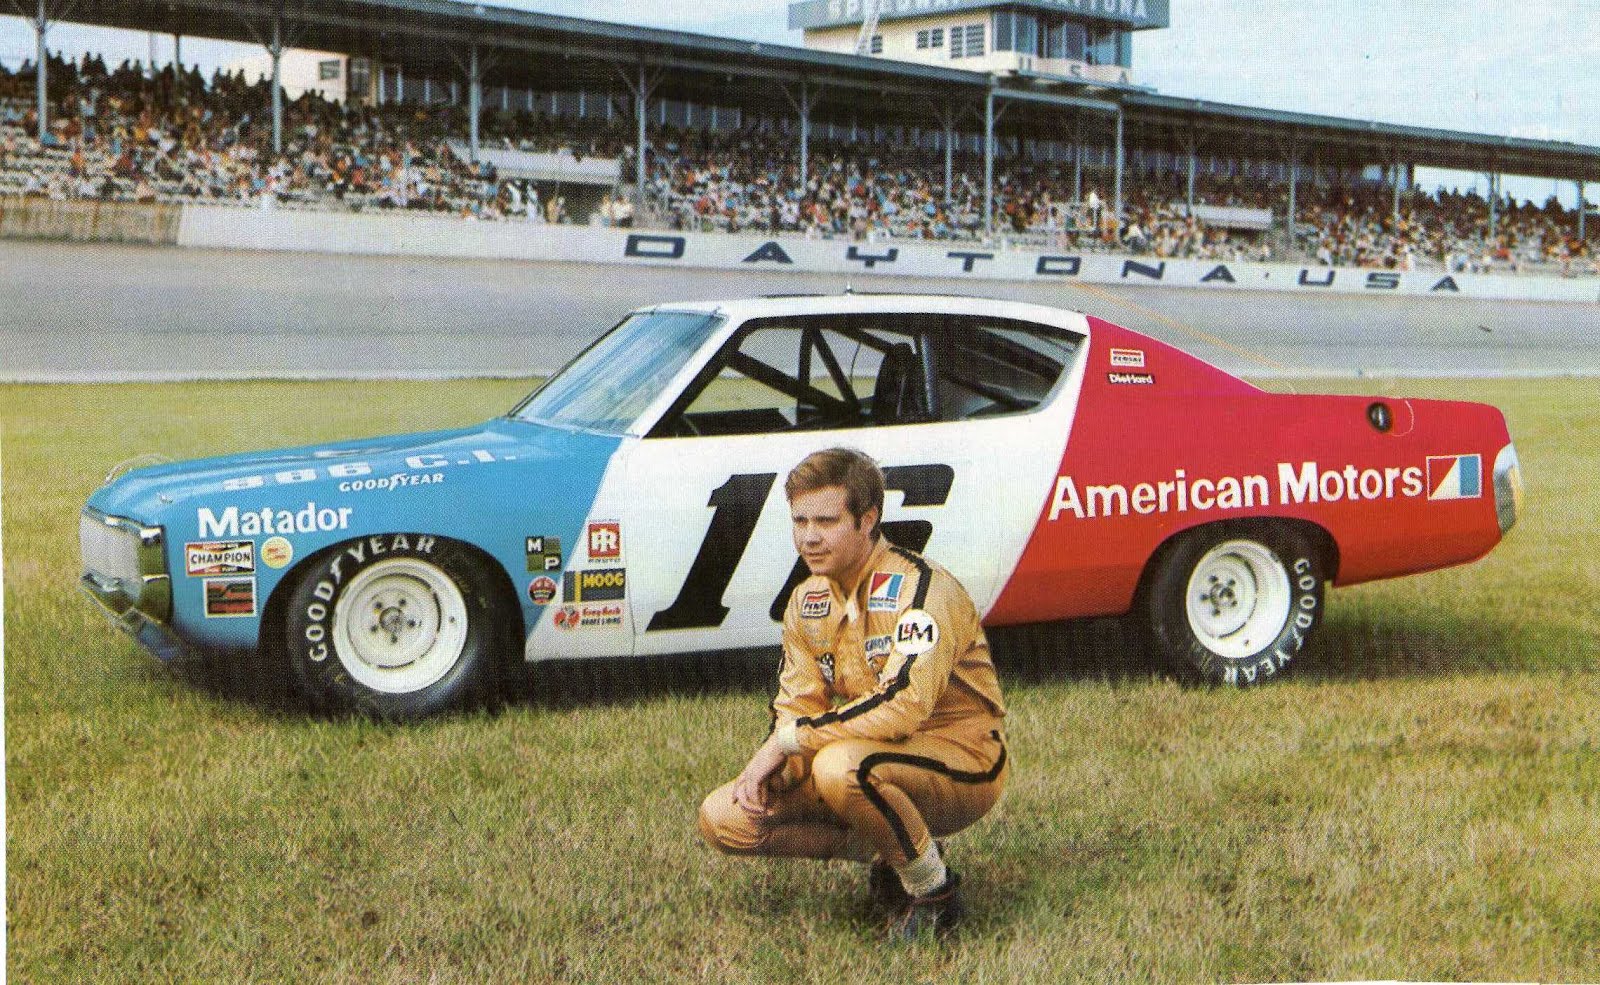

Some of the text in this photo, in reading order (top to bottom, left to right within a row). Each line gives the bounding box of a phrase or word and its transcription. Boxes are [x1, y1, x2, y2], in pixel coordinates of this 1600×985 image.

[624, 234, 1460, 292] DAYTONA USA
[339, 472, 444, 492] GOODYEAR
[1047, 460, 1424, 522] American Motors
[197, 502, 352, 538] Matador
[191, 551, 251, 564] CHAMPION
[583, 572, 625, 588] MOOG
[897, 622, 934, 643] L&M
